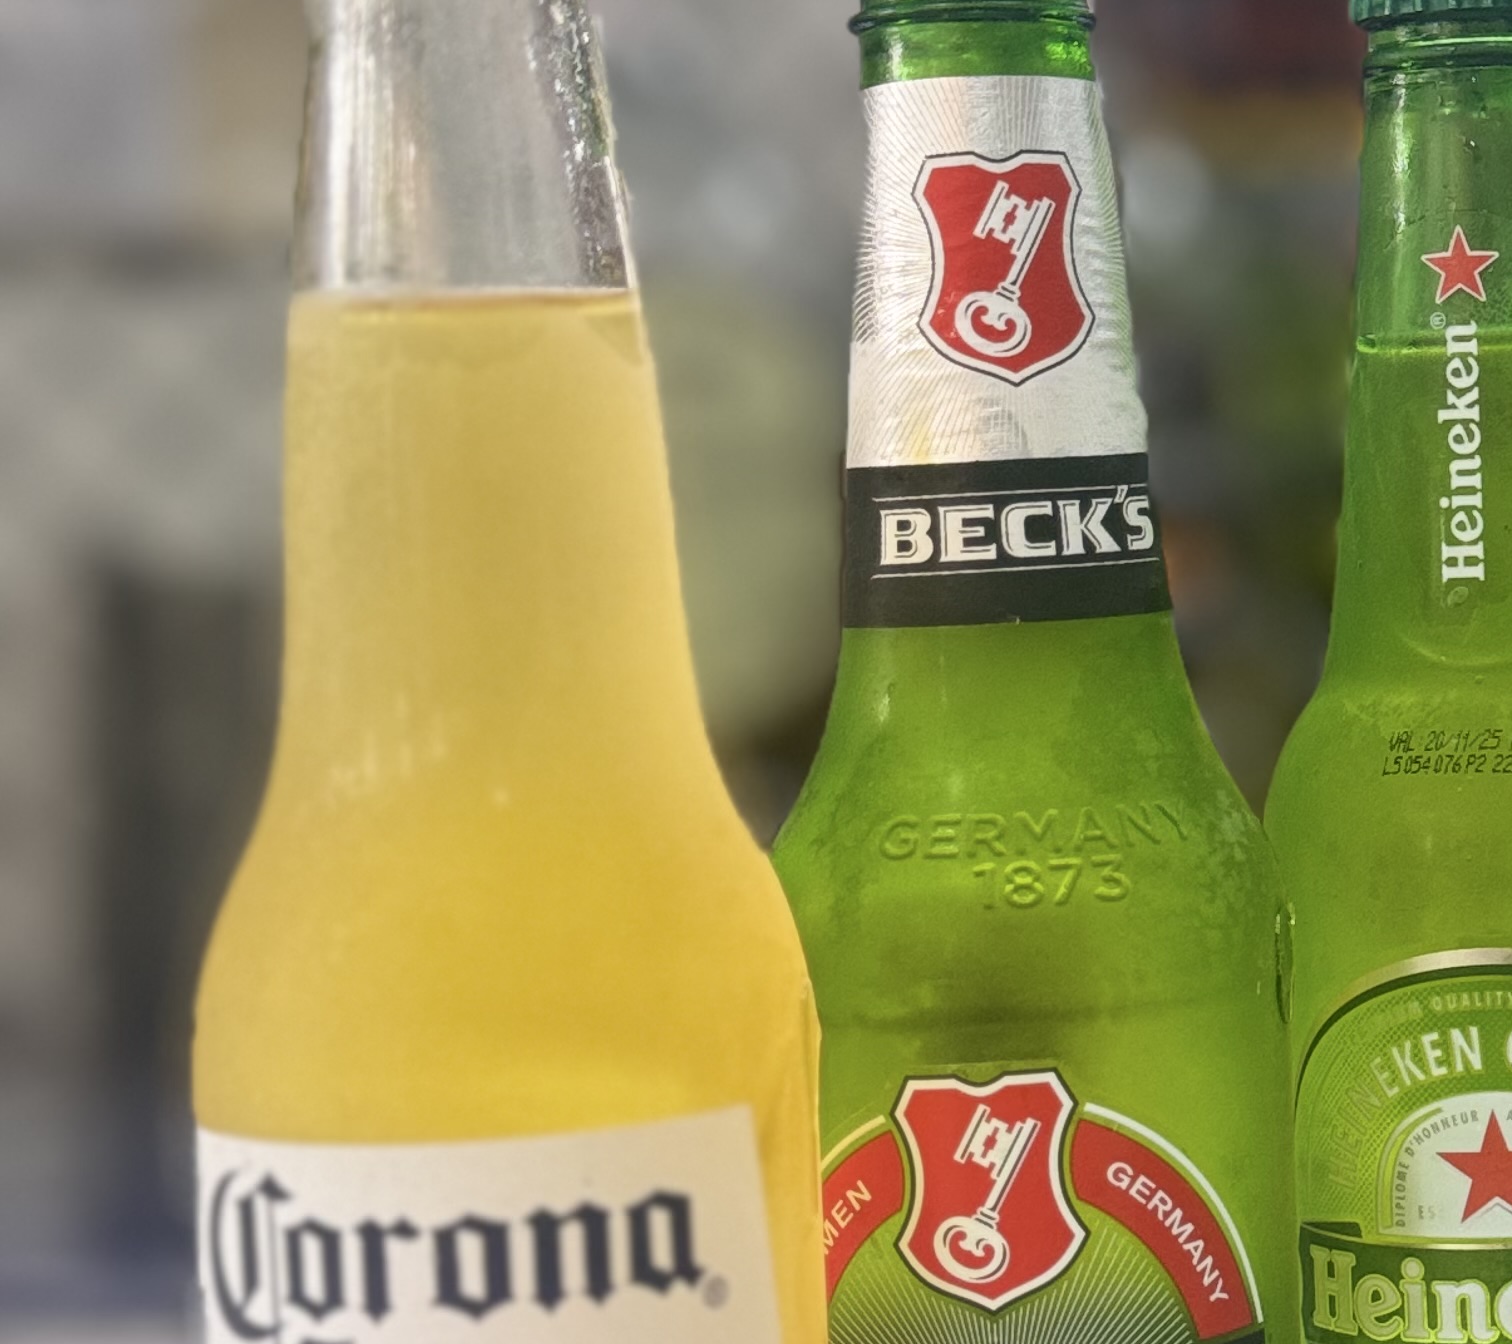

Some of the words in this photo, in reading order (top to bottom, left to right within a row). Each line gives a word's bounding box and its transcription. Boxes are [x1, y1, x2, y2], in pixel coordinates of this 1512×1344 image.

[1437, 319, 1486, 584] Heineken
[879, 485, 1155, 567] BECK'S
[878, 799, 1188, 860] GERMANY
[971, 854, 1132, 910] 1873
[1395, 1161, 1410, 1228] DIPLOME
[1406, 1109, 1480, 1158] D'HONNEUR
[1105, 1160, 1230, 1305] GERMANY
